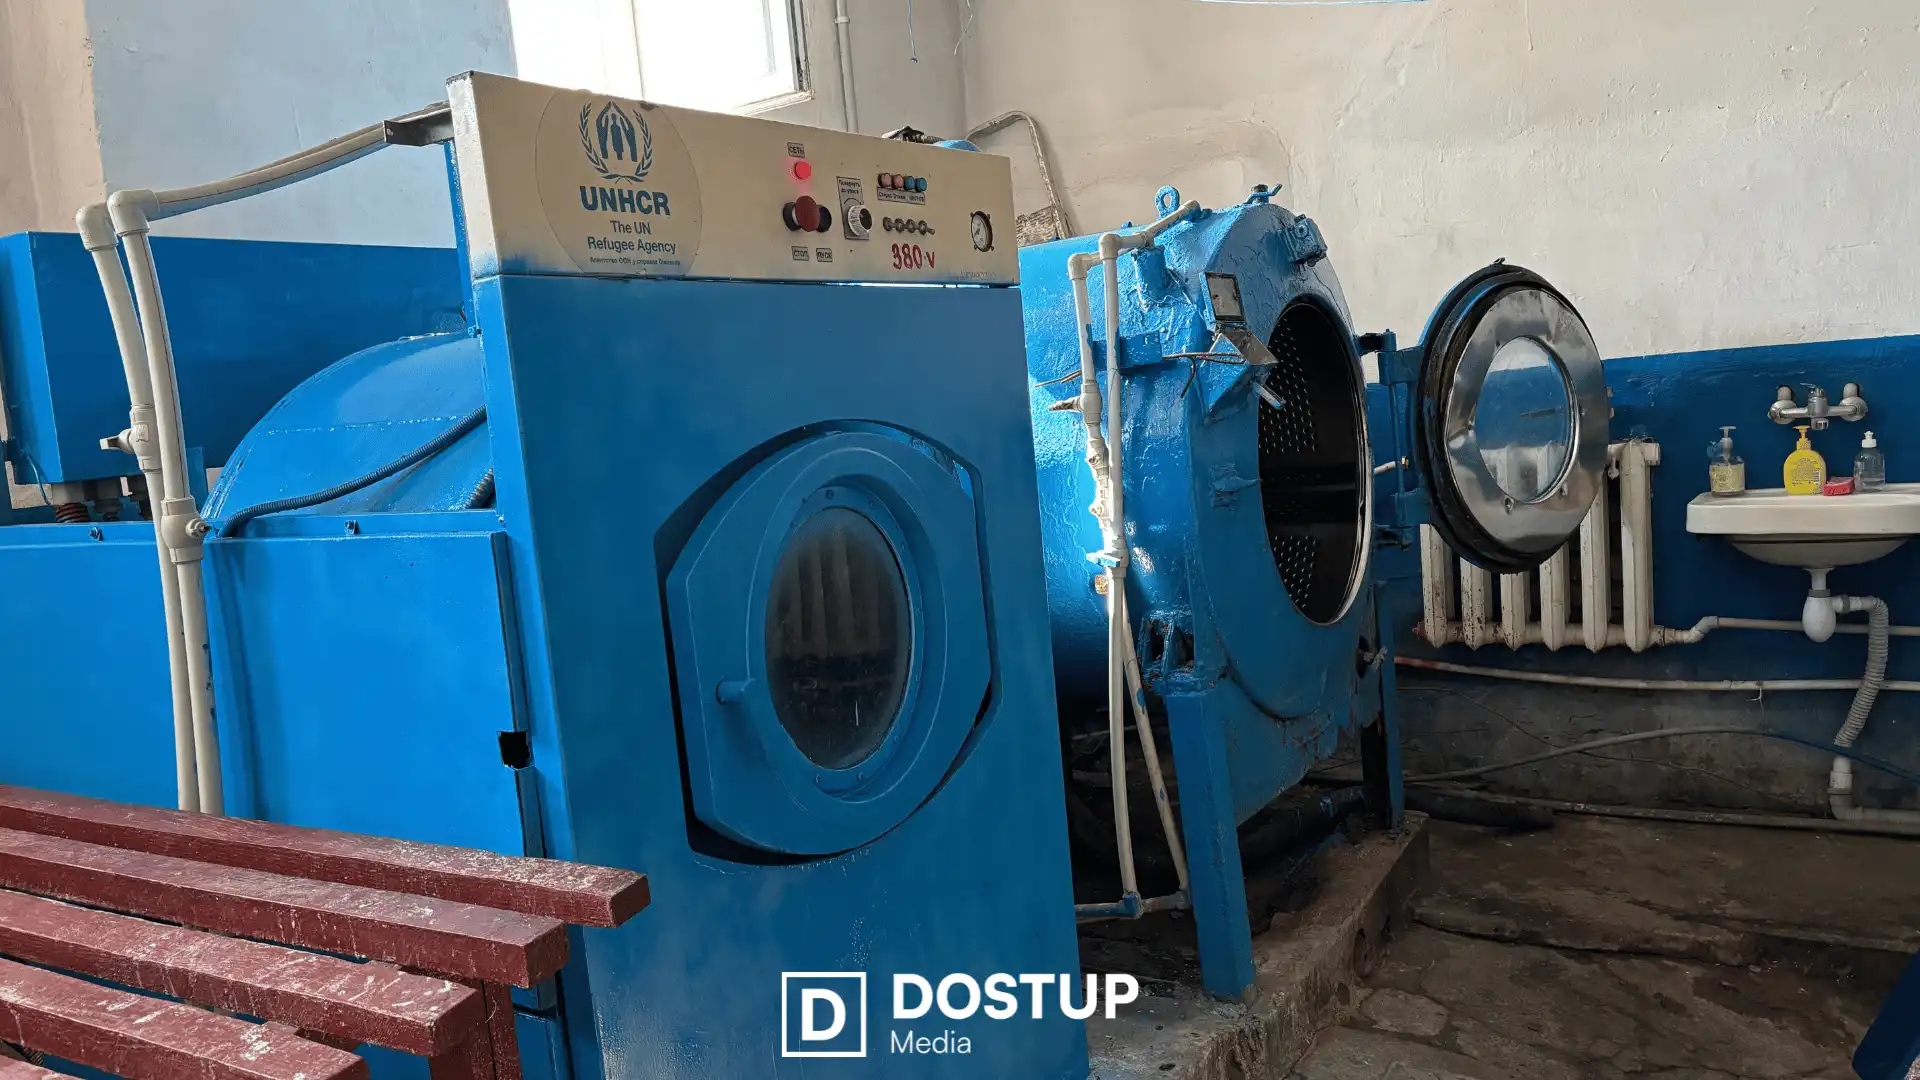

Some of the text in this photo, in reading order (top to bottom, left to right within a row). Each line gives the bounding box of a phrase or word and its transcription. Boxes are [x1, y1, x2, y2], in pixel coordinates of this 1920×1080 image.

[579, 186, 671, 216] UNHCR
[610, 220, 652, 235] The UN
[587, 236, 676, 255] Refugee Agency
